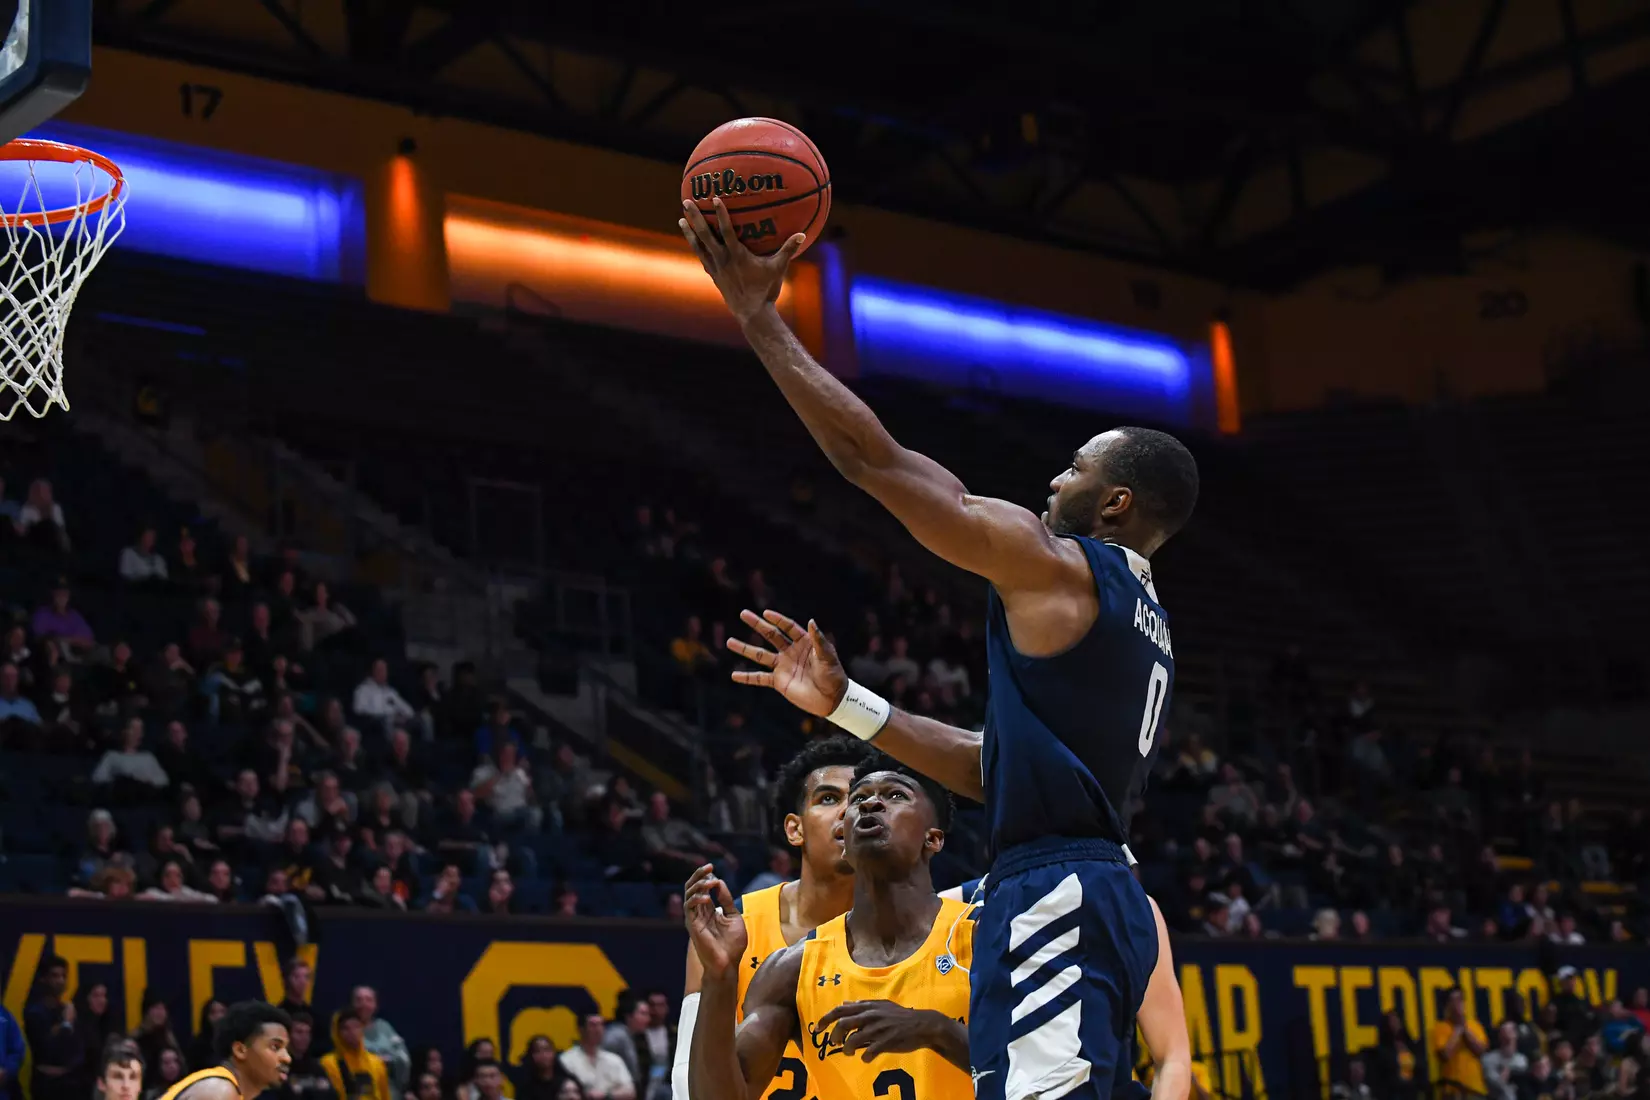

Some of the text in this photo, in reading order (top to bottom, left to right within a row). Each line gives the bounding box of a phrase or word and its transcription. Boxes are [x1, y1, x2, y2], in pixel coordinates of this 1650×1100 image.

[179, 82, 224, 121] 17
[690, 168, 785, 201] Wilson
[1138, 660, 1168, 758] 0
